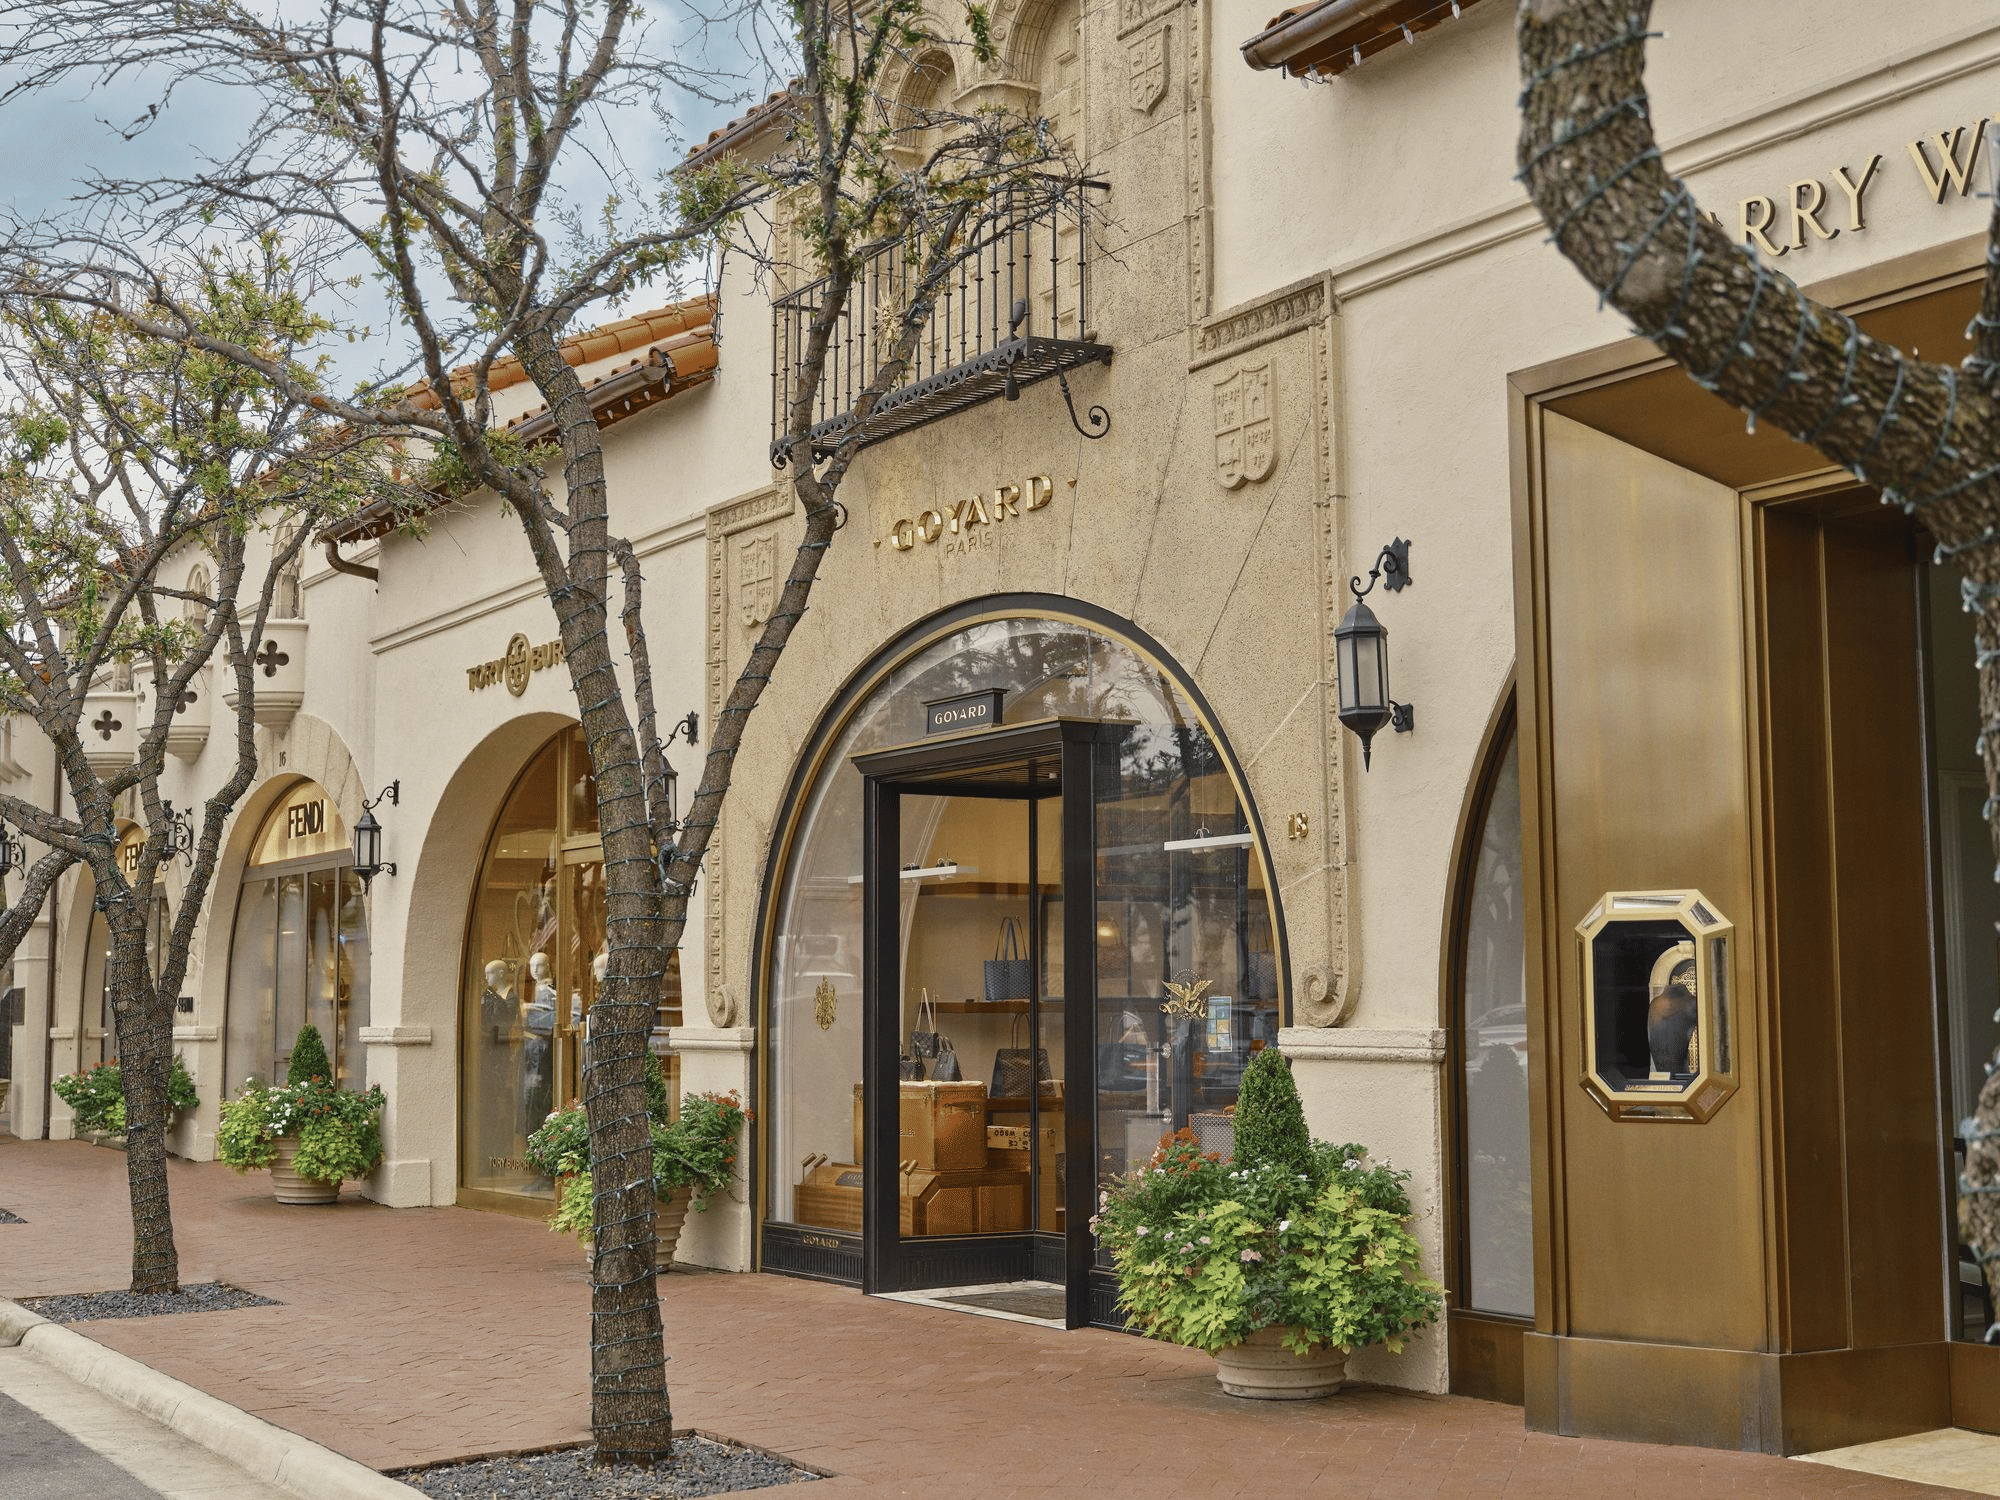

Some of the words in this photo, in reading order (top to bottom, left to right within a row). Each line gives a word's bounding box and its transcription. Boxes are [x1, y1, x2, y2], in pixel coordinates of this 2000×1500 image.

[1708, 155, 1883, 256] RRY
[1906, 112, 2000, 204] W
[892, 475, 1053, 551] GOYARD
[946, 531, 993, 558] PARIS
[466, 657, 505, 692] TORY
[935, 704, 986, 724] GOYARD
[279, 751, 287, 767] 16
[288, 799, 326, 839] FENDI
[1287, 812, 1308, 839] 18
[489, 1156, 507, 1168] TORY
[803, 1235, 839, 1249] GOYARD
